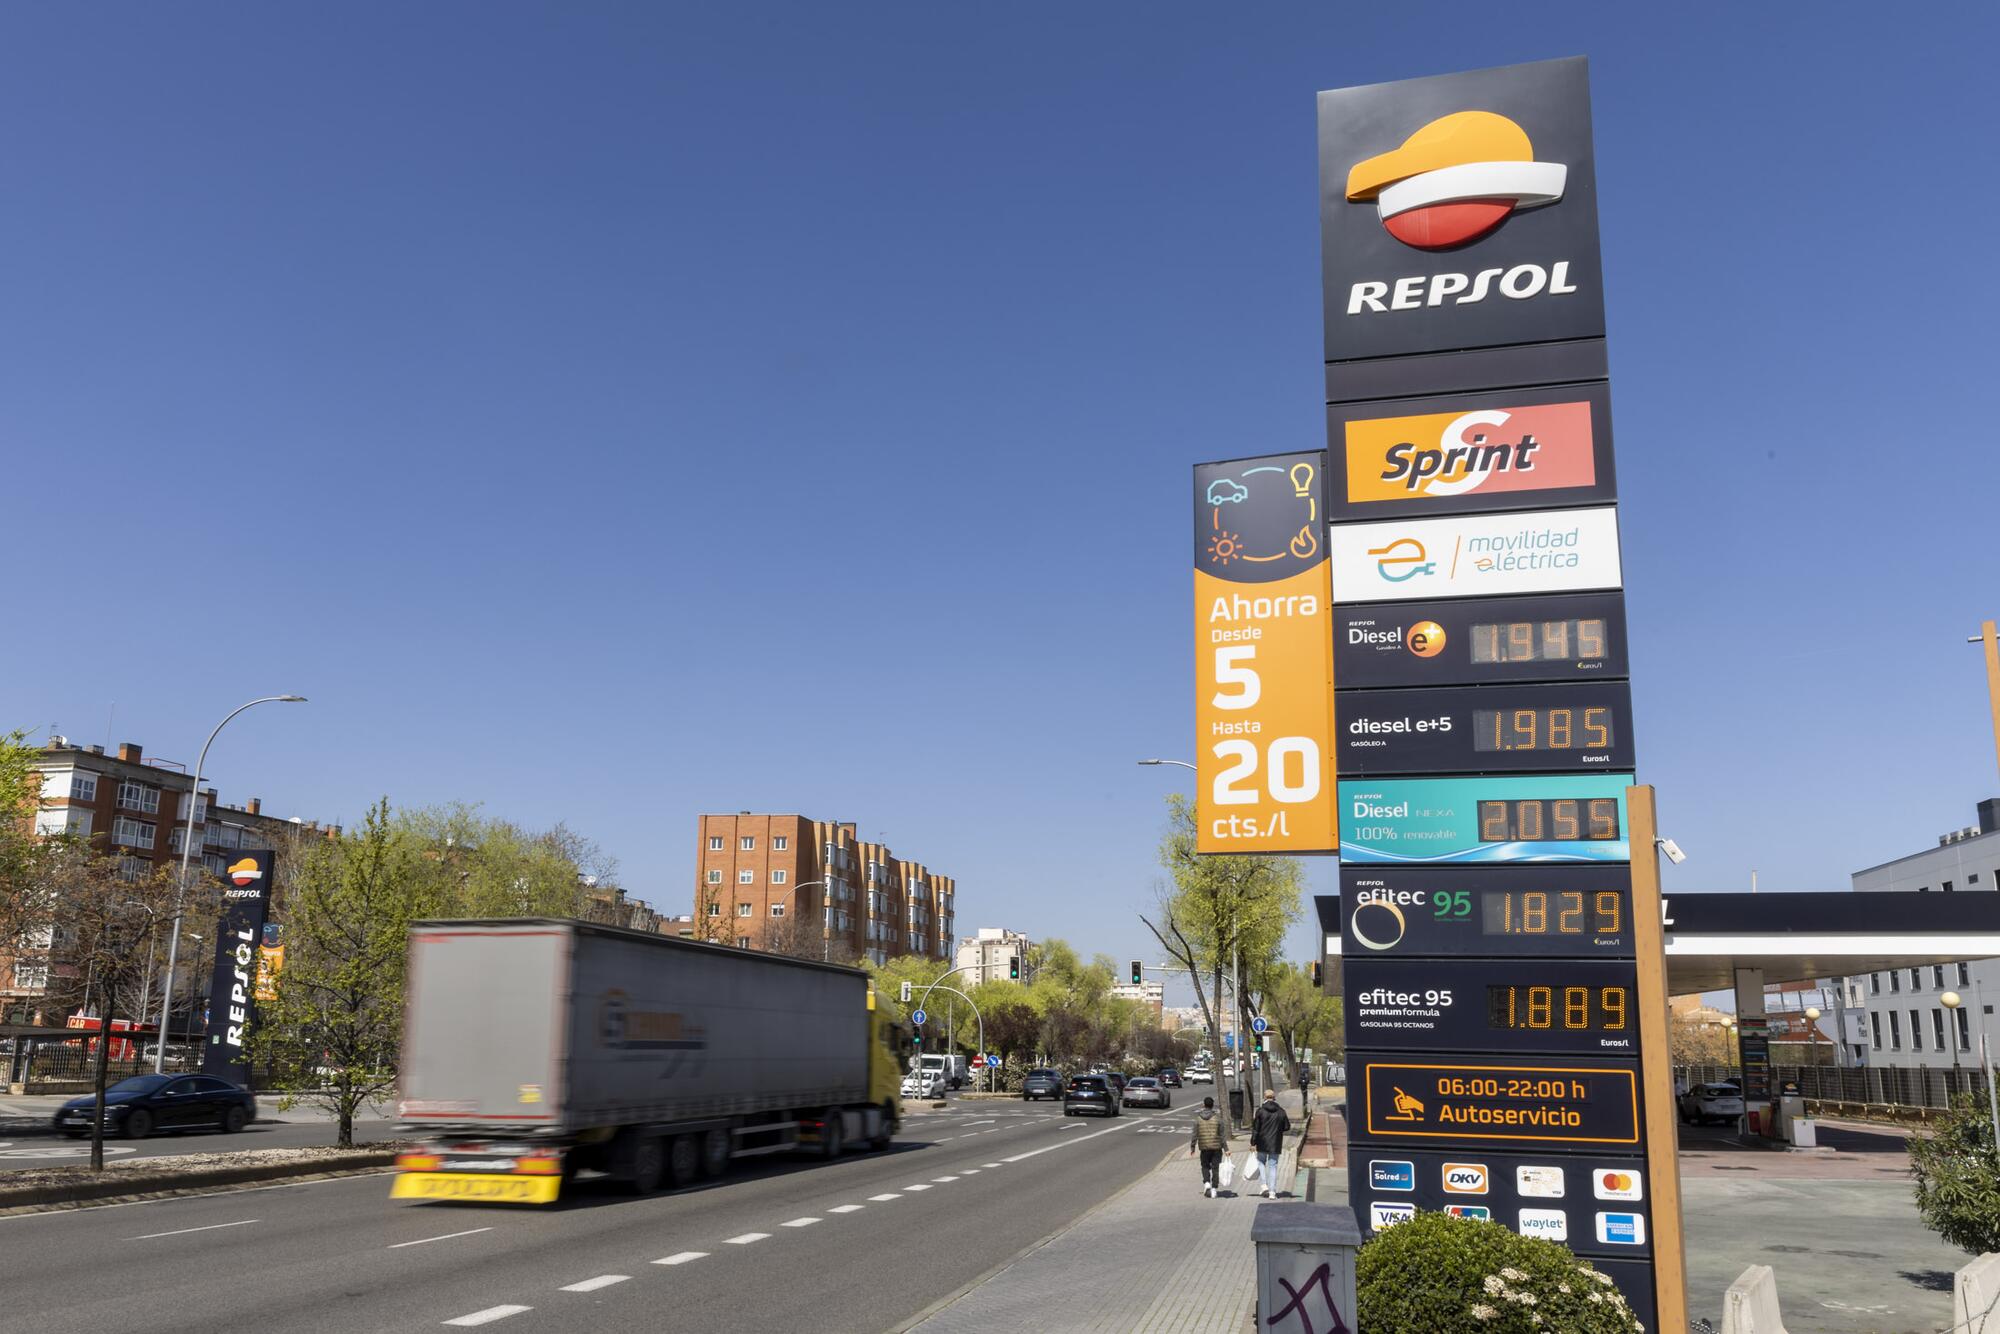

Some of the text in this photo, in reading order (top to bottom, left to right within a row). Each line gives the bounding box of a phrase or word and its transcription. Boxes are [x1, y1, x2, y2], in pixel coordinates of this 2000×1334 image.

[1347, 261, 1577, 315] REPSOL
[1381, 433, 1539, 489] Sprint
[1468, 527, 1579, 552] movilidad
[1474, 551, 1579, 572] eléctrica
[1210, 593, 1317, 622] Ahorra
[1211, 626, 1262, 642] Desde
[1348, 626, 1402, 644] Diesel
[1491, 619, 1601, 662] 1.945
[1211, 645, 1261, 710] 5
[1212, 720, 1261, 735] Hasta
[1349, 717, 1452, 733] diesel e+5
[1495, 708, 1607, 749] 1.985
[1212, 736, 1320, 805] 20
[1353, 801, 1454, 818] Diesel NEXA
[1484, 800, 1615, 840] 2.055
[1212, 811, 1290, 838] cts./l
[1355, 827, 1457, 840] 100% renovable
[225, 889, 261, 898] REPSOL
[1357, 889, 1472, 916] efitec 95
[1505, 892, 1619, 933] 1.829
[227, 928, 254, 1047] REPSOL
[1359, 988, 1453, 1006] efitec 95
[1509, 986, 1625, 1029] 1.889
[69, 1018, 86, 1029] CAR
[1600, 1039, 1629, 1047] Euros/l
[1438, 1078, 1585, 1099] 06:00-22:00 h
[1439, 1104, 1581, 1127] Autoservicio
[1374, 1172, 1400, 1181] Solred
[1450, 1173, 1481, 1184] DKV
